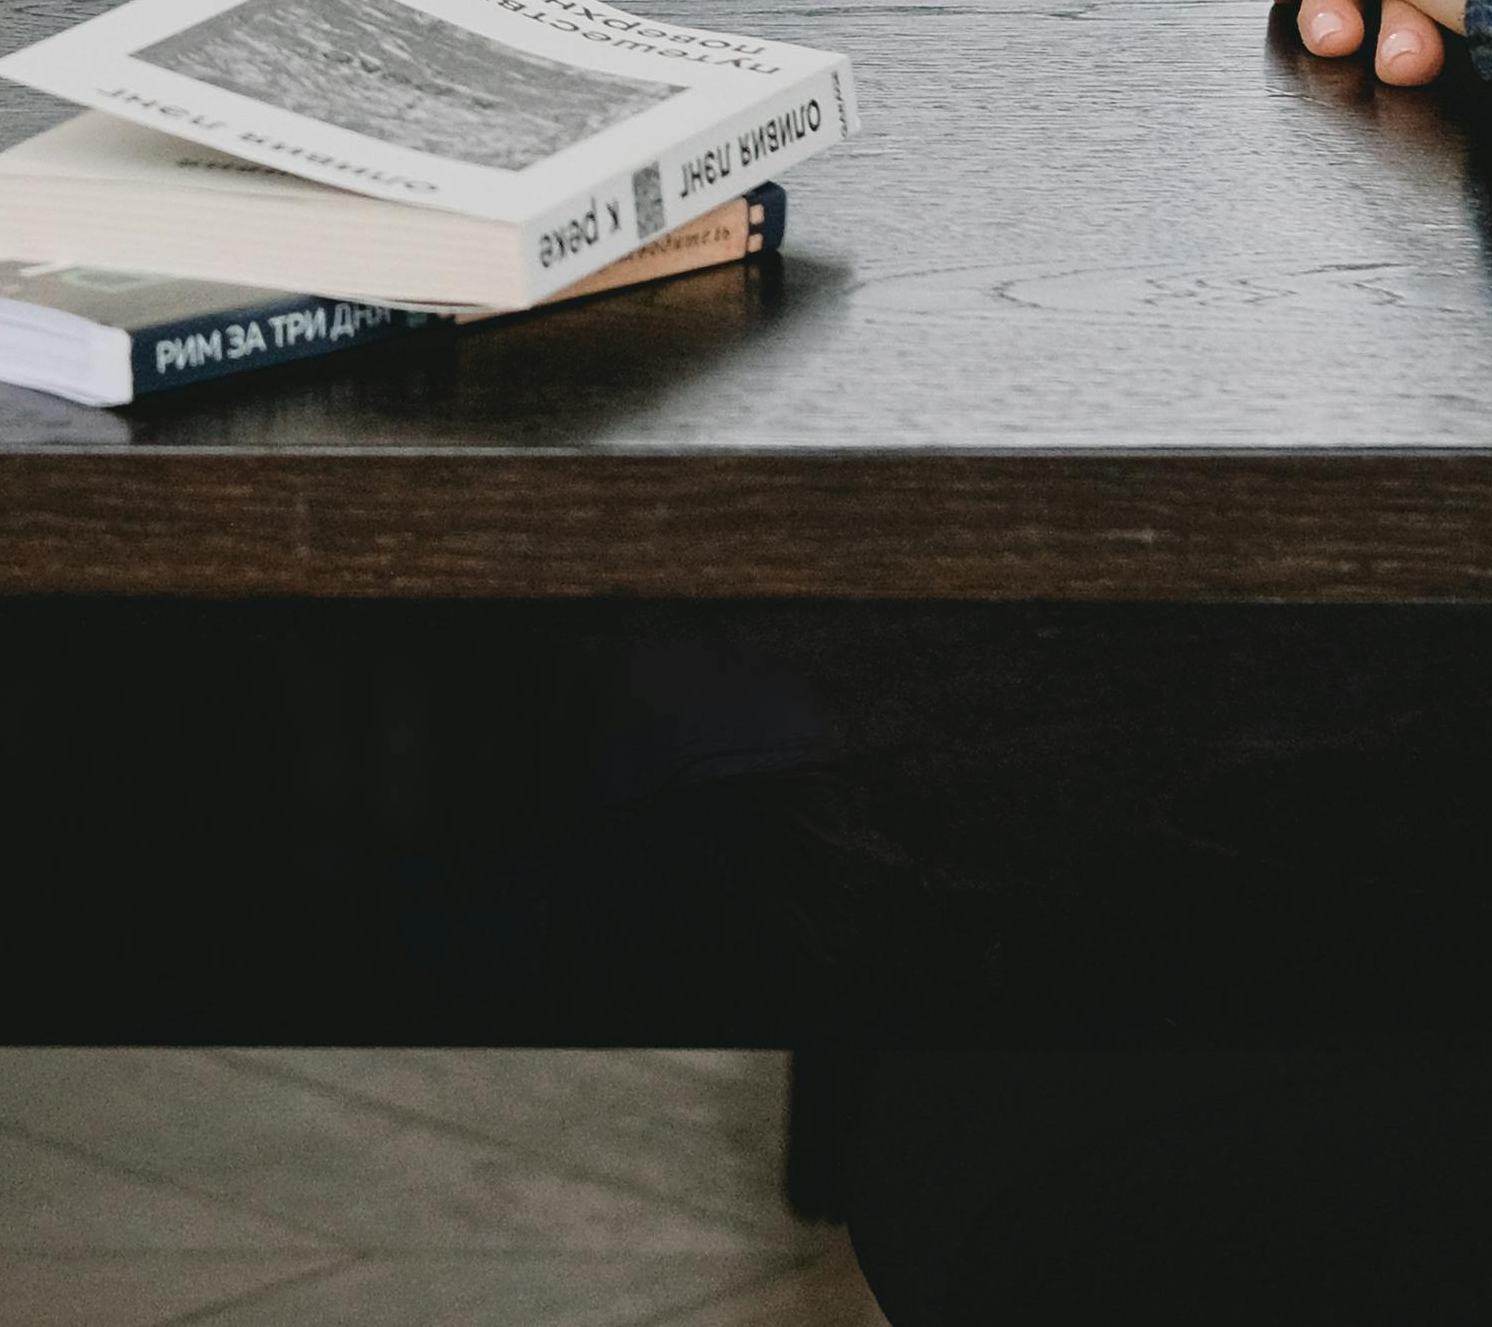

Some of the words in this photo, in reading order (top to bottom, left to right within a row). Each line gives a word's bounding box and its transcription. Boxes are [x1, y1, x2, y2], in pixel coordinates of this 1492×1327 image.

[537, 194, 600, 269] реке
[606, 200, 621, 233] к
[155, 328, 223, 374] РИМ
[225, 320, 267, 360] ЗА
[267, 305, 328, 348] ТРИ
